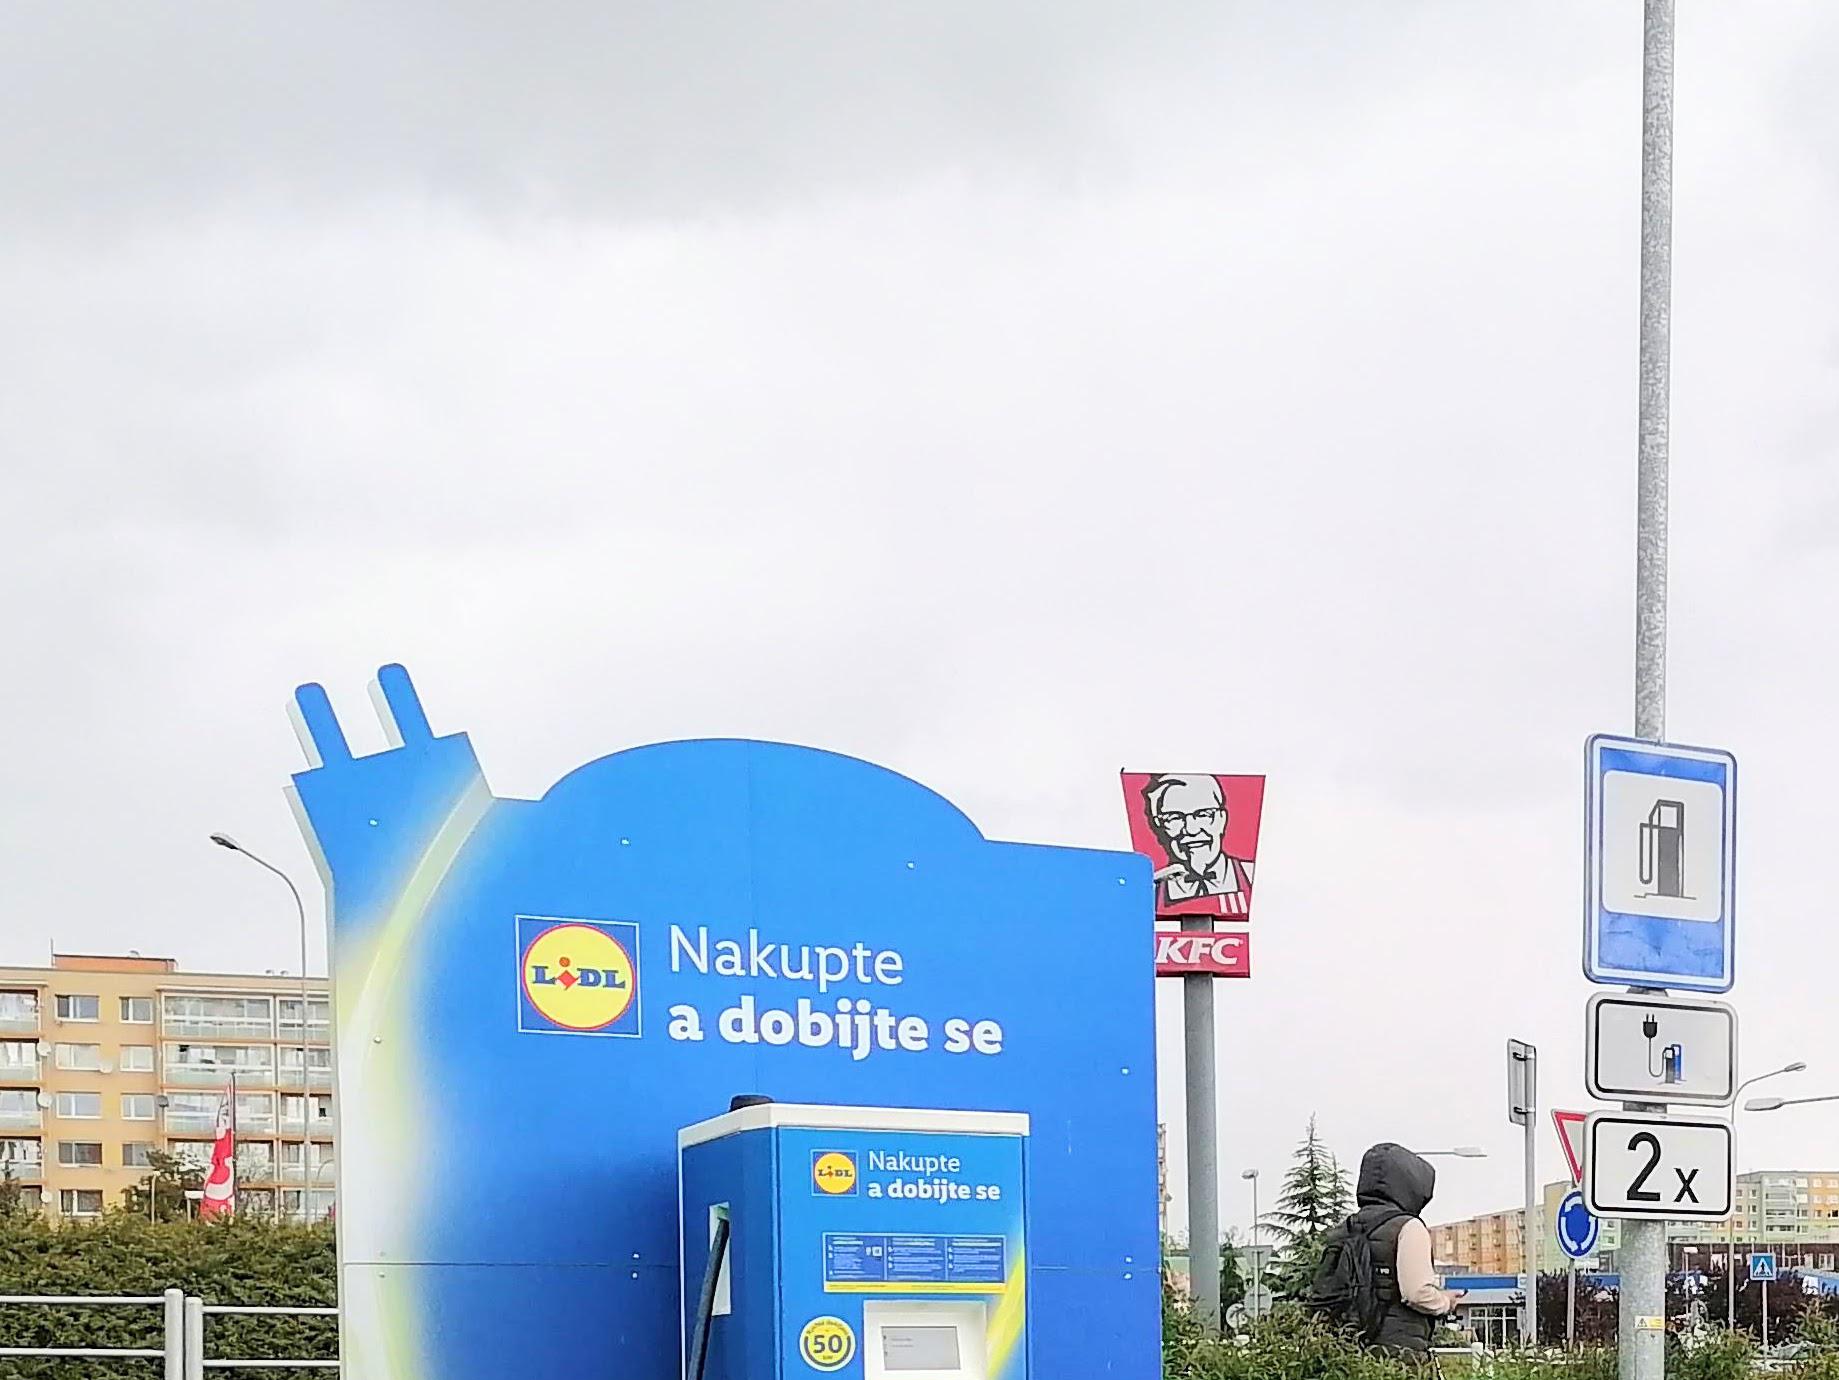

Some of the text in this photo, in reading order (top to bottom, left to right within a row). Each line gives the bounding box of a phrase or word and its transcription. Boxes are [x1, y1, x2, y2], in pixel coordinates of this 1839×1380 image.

[669, 924, 904, 993] Nakupte
[1155, 936, 1243, 965] KFC
[531, 956, 626, 991] LIDL
[668, 995, 1003, 1061] a dobijte se
[817, 1165, 853, 1178] LIDL
[868, 1151, 960, 1176] Nakupte
[867, 1178, 1001, 1205] a dobijte se
[813, 1334, 843, 1354] 50
